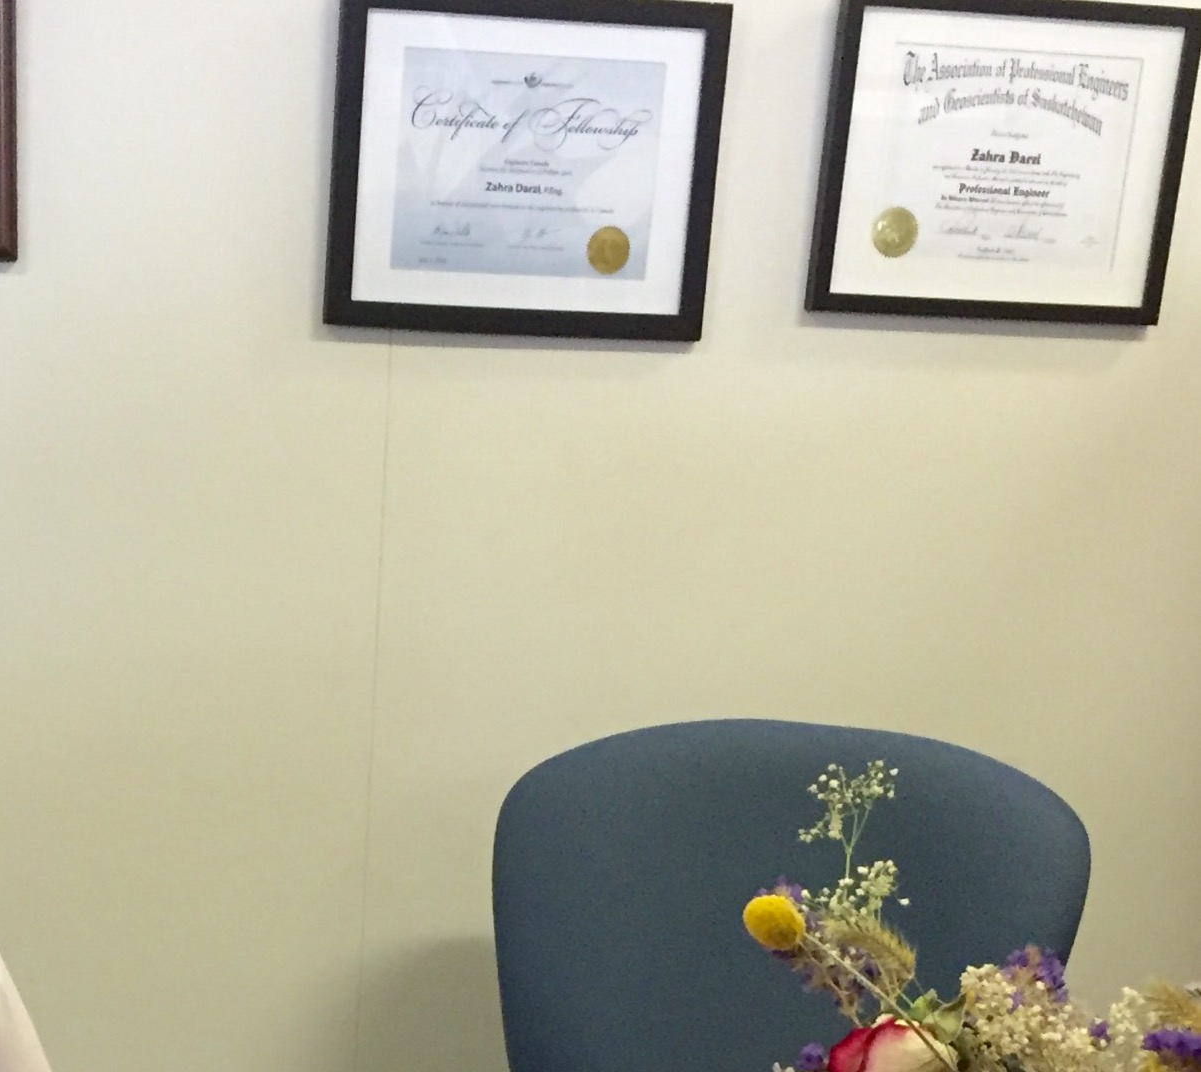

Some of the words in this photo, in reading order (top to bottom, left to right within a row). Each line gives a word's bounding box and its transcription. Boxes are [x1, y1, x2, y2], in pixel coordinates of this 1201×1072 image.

[902, 50, 927, 91] The
[927, 52, 993, 83] Association
[995, 59, 1006, 78] of
[1009, 58, 1076, 86] Professional
[1077, 63, 1130, 102] Engineers
[410, 85, 499, 141] Certificate
[498, 109, 530, 143] of
[529, 97, 653, 152] Fellowship
[917, 97, 940, 125] and
[943, 88, 1015, 114] Geoscientists
[1017, 87, 1029, 106] of
[970, 148, 1005, 163] Zahra
[1009, 150, 1042, 166] Darzi
[485, 181, 514, 193] Zahra
[958, 182, 1011, 196] Professional
[1013, 185, 1051, 199] Engineer
